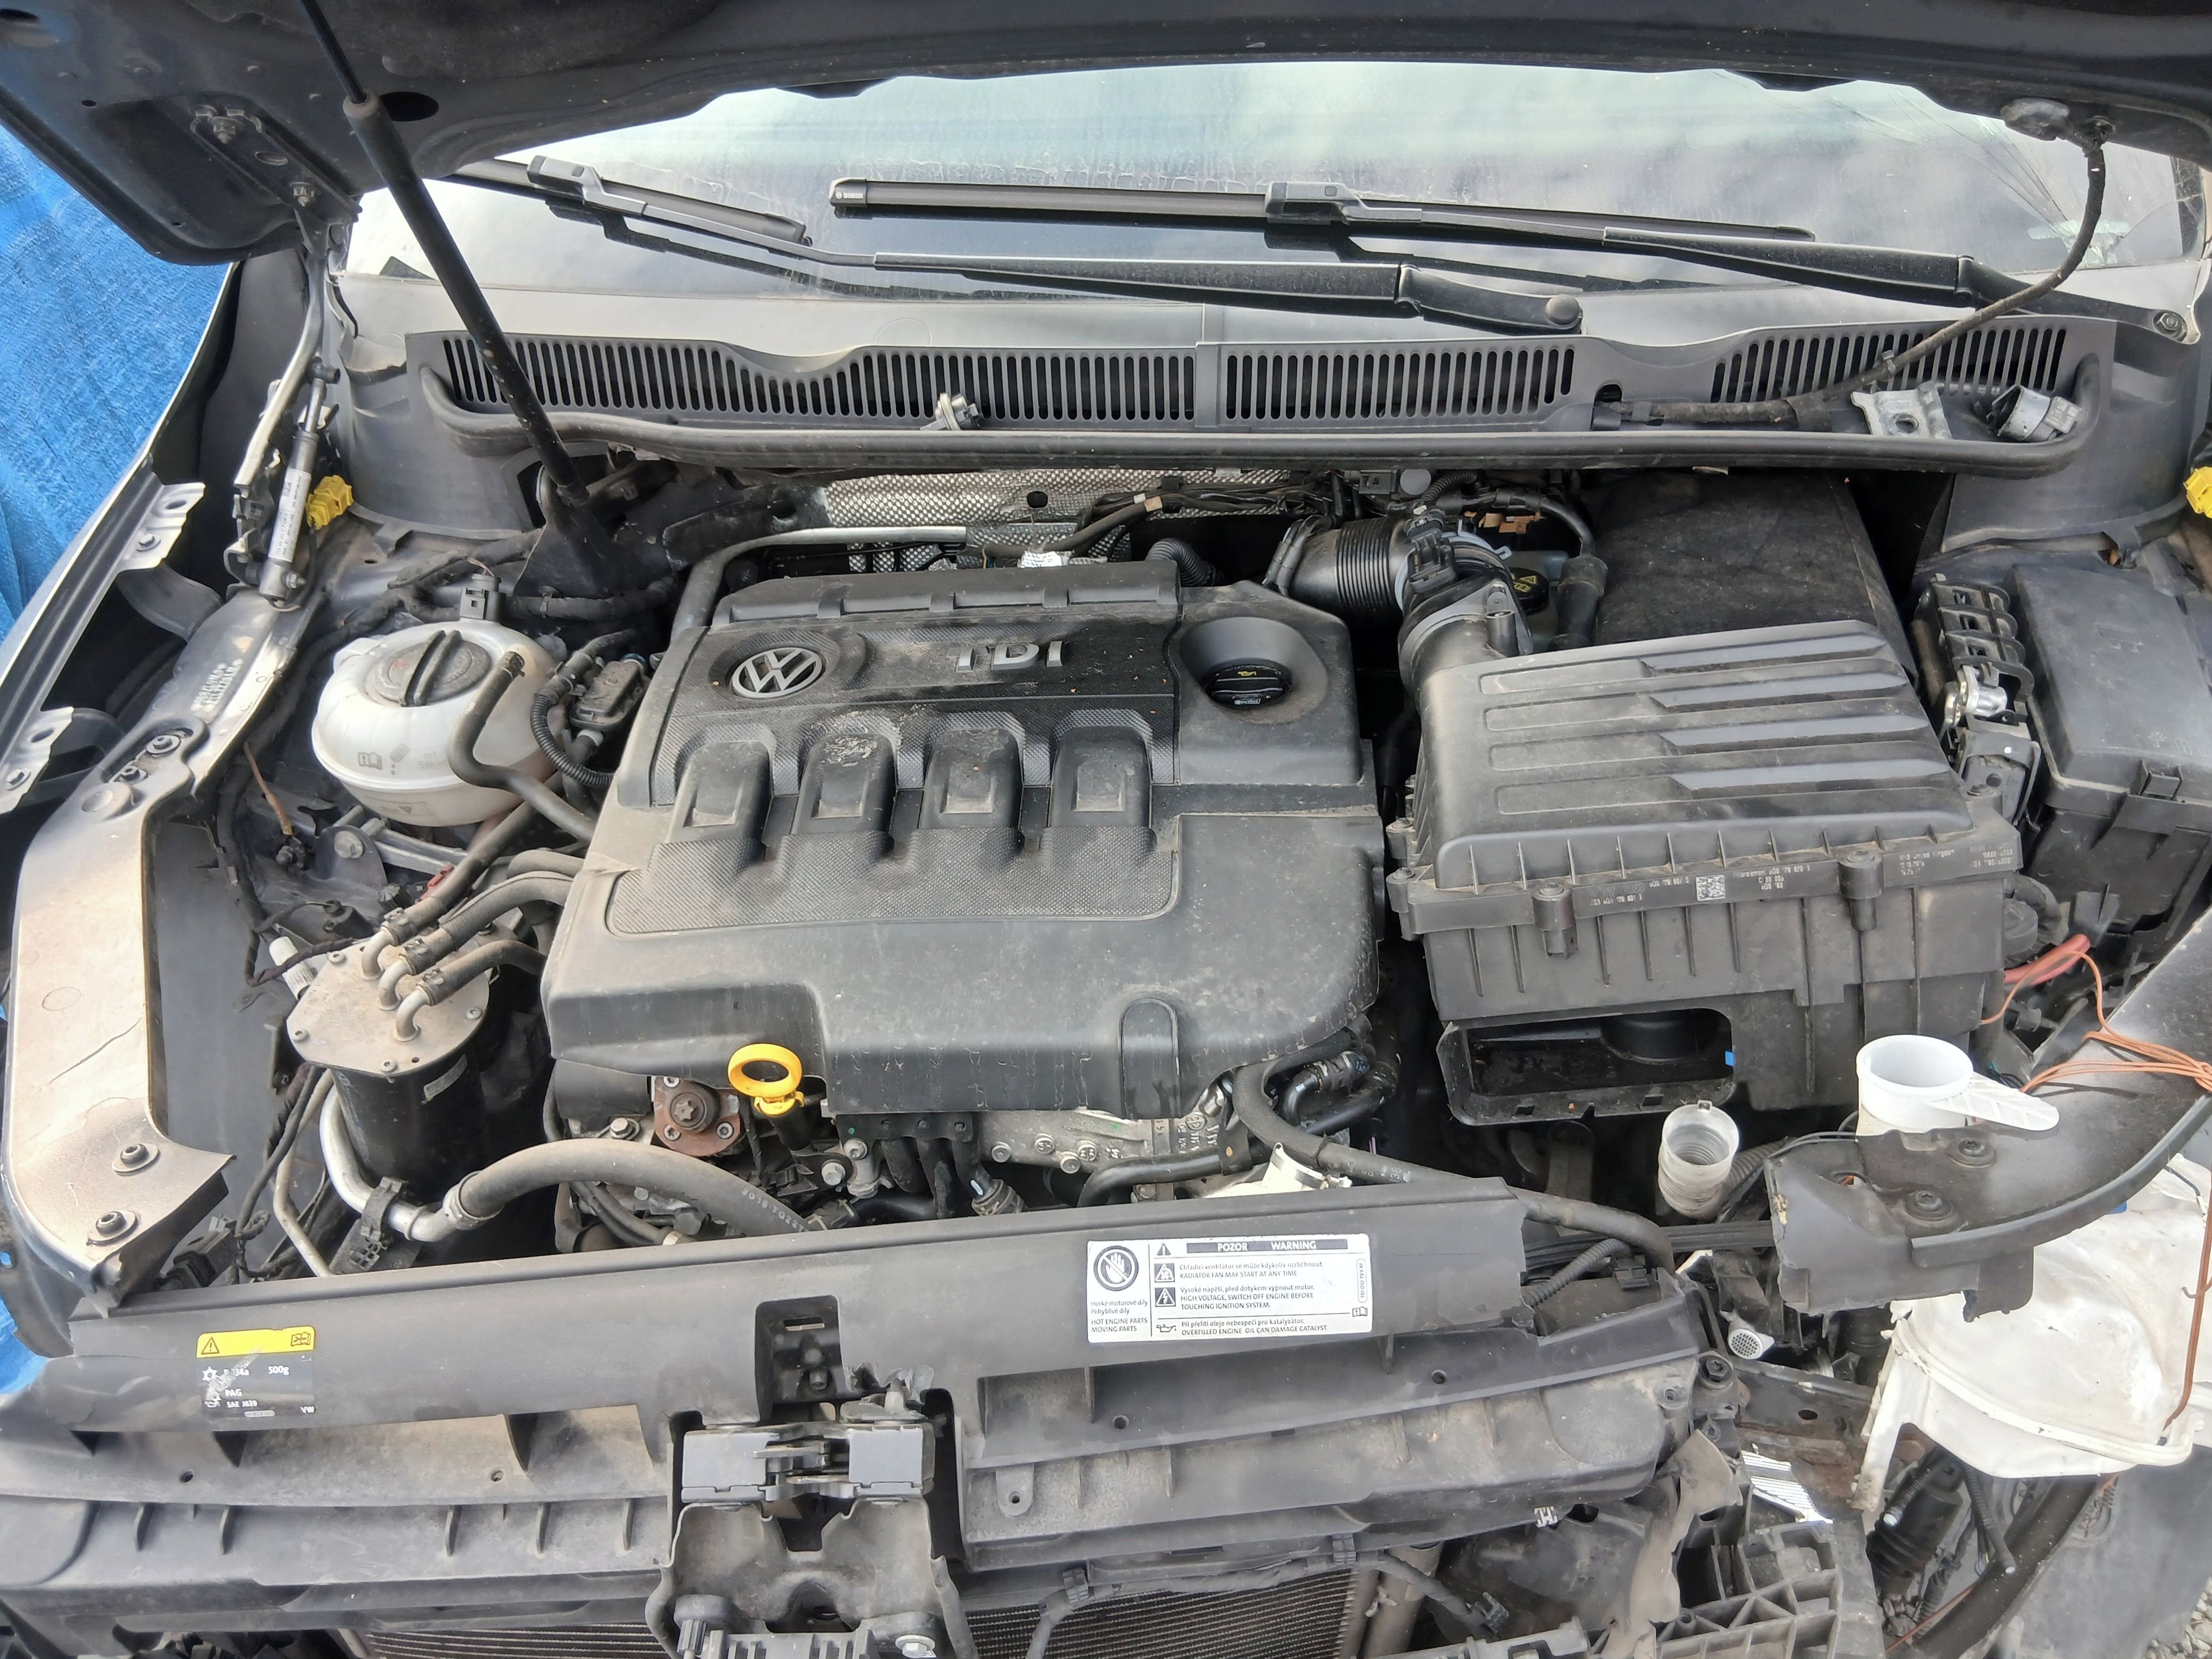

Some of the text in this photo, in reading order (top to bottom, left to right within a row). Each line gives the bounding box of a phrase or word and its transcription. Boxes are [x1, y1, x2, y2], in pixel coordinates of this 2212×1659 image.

[946, 641, 1063, 672] TDI
[1217, 1240, 1317, 1252] POZOR WARNING
[268, 1365, 290, 1376] 500g
[225, 1388, 243, 1397] PAG
